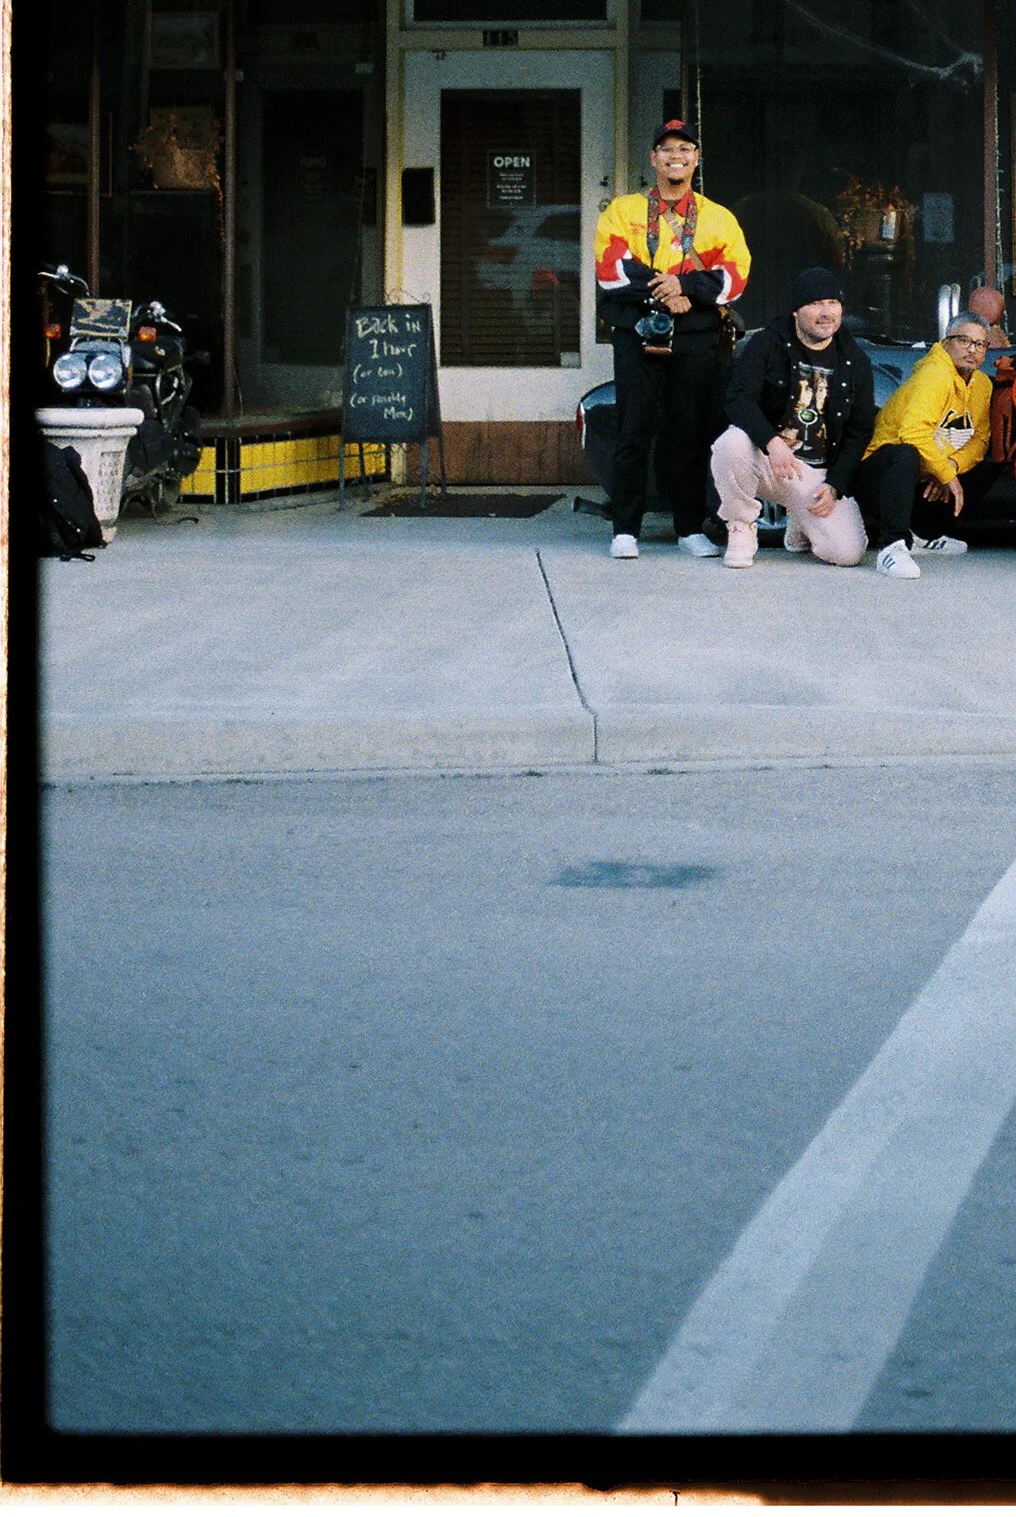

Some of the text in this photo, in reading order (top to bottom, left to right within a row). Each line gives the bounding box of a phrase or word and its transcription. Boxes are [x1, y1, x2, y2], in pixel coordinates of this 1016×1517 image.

[493, 156, 530, 168] OPEN
[356, 314, 398, 338] Back
[383, 341, 417, 356] hour
